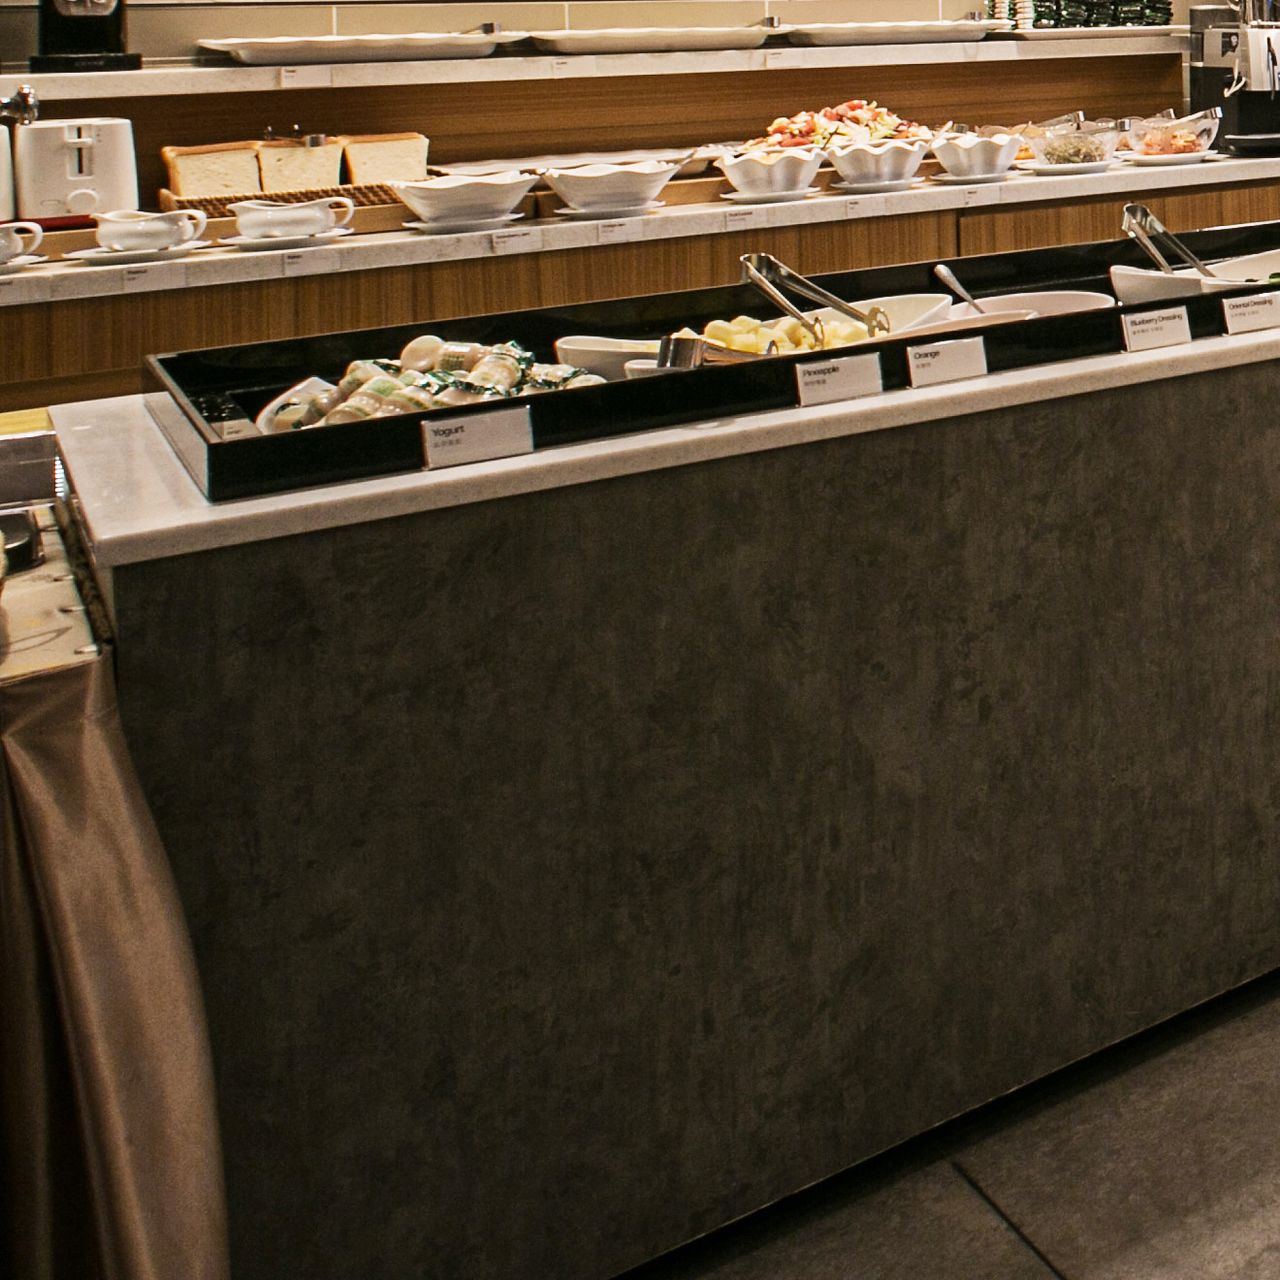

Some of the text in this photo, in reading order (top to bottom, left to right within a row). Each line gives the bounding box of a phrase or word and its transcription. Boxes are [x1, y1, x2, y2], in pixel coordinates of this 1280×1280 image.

[914, 350, 940, 360] Orange
[803, 366, 840, 377] Pineapple
[432, 426, 465, 437] Yogurt
